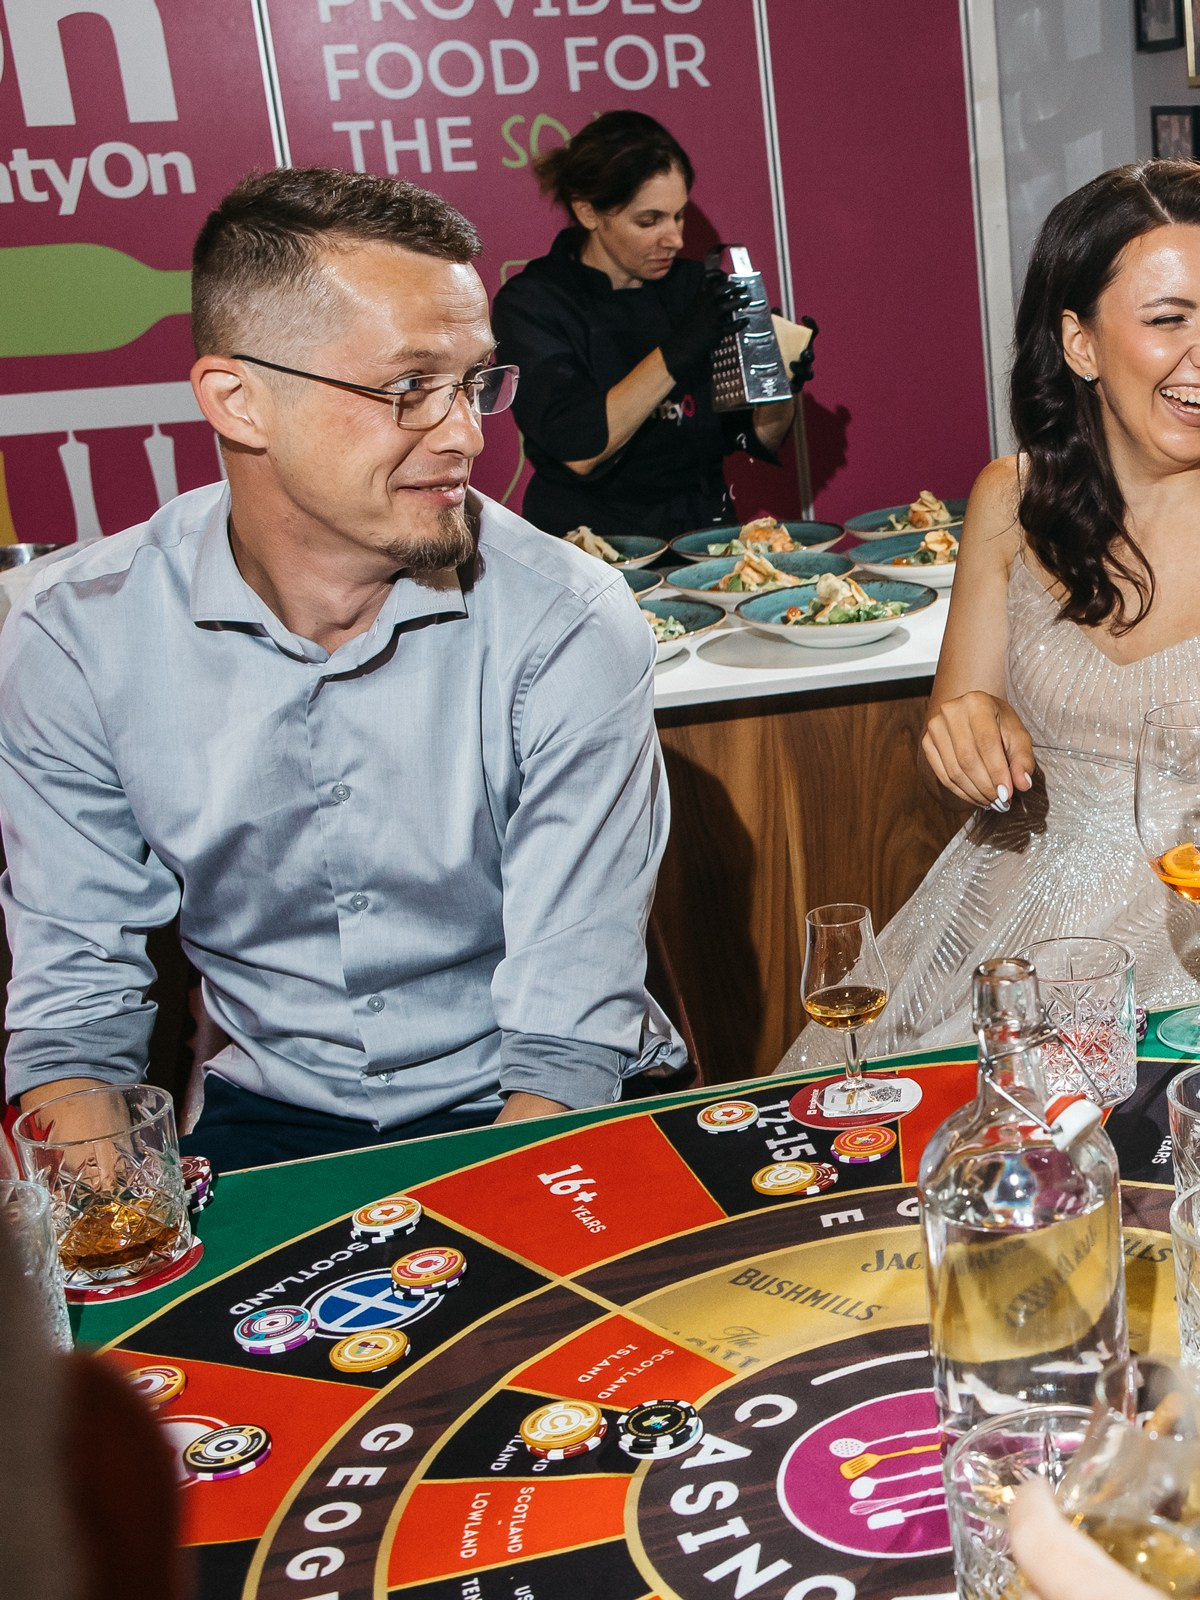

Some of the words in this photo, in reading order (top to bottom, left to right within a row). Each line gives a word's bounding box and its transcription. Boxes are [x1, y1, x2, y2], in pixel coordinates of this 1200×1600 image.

[322, 39, 540, 101] FOOD
[564, 33, 711, 93] FOR
[332, 116, 478, 175] THE
[537, 1164, 598, 1203] 16+
[571, 1204, 607, 1234] YEARS
[229, 1241, 370, 1316] SCOTLAND
[728, 1267, 883, 1321] BUSHMILLS
[861, 1248, 924, 1274] JAC
[577, 1343, 639, 1384] ISLAND
[596, 1348, 676, 1400] SCOTLAND
[284, 1422, 414, 1600] GEOG
[460, 1492, 491, 1559] LOWLAND
[506, 1486, 536, 1554] SCOTLAND
